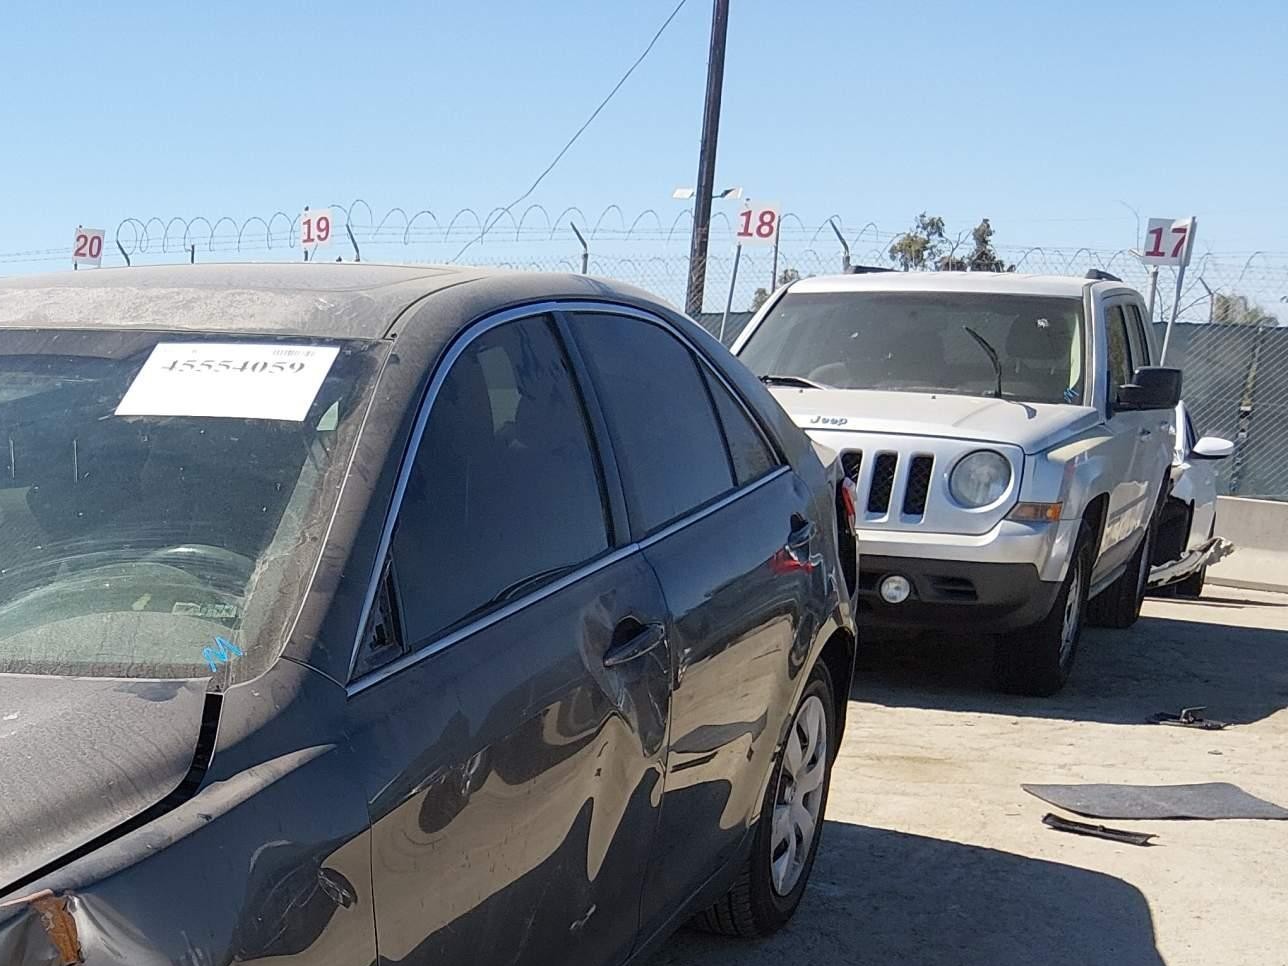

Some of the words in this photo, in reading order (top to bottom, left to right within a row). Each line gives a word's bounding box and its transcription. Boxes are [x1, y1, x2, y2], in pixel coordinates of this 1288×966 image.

[302, 216, 330, 243] 19
[737, 210, 776, 238] 18
[74, 234, 102, 258] 20
[1145, 227, 1188, 258] 17
[161, 359, 305, 373] 45554059
[810, 415, 848, 426] Jeep
